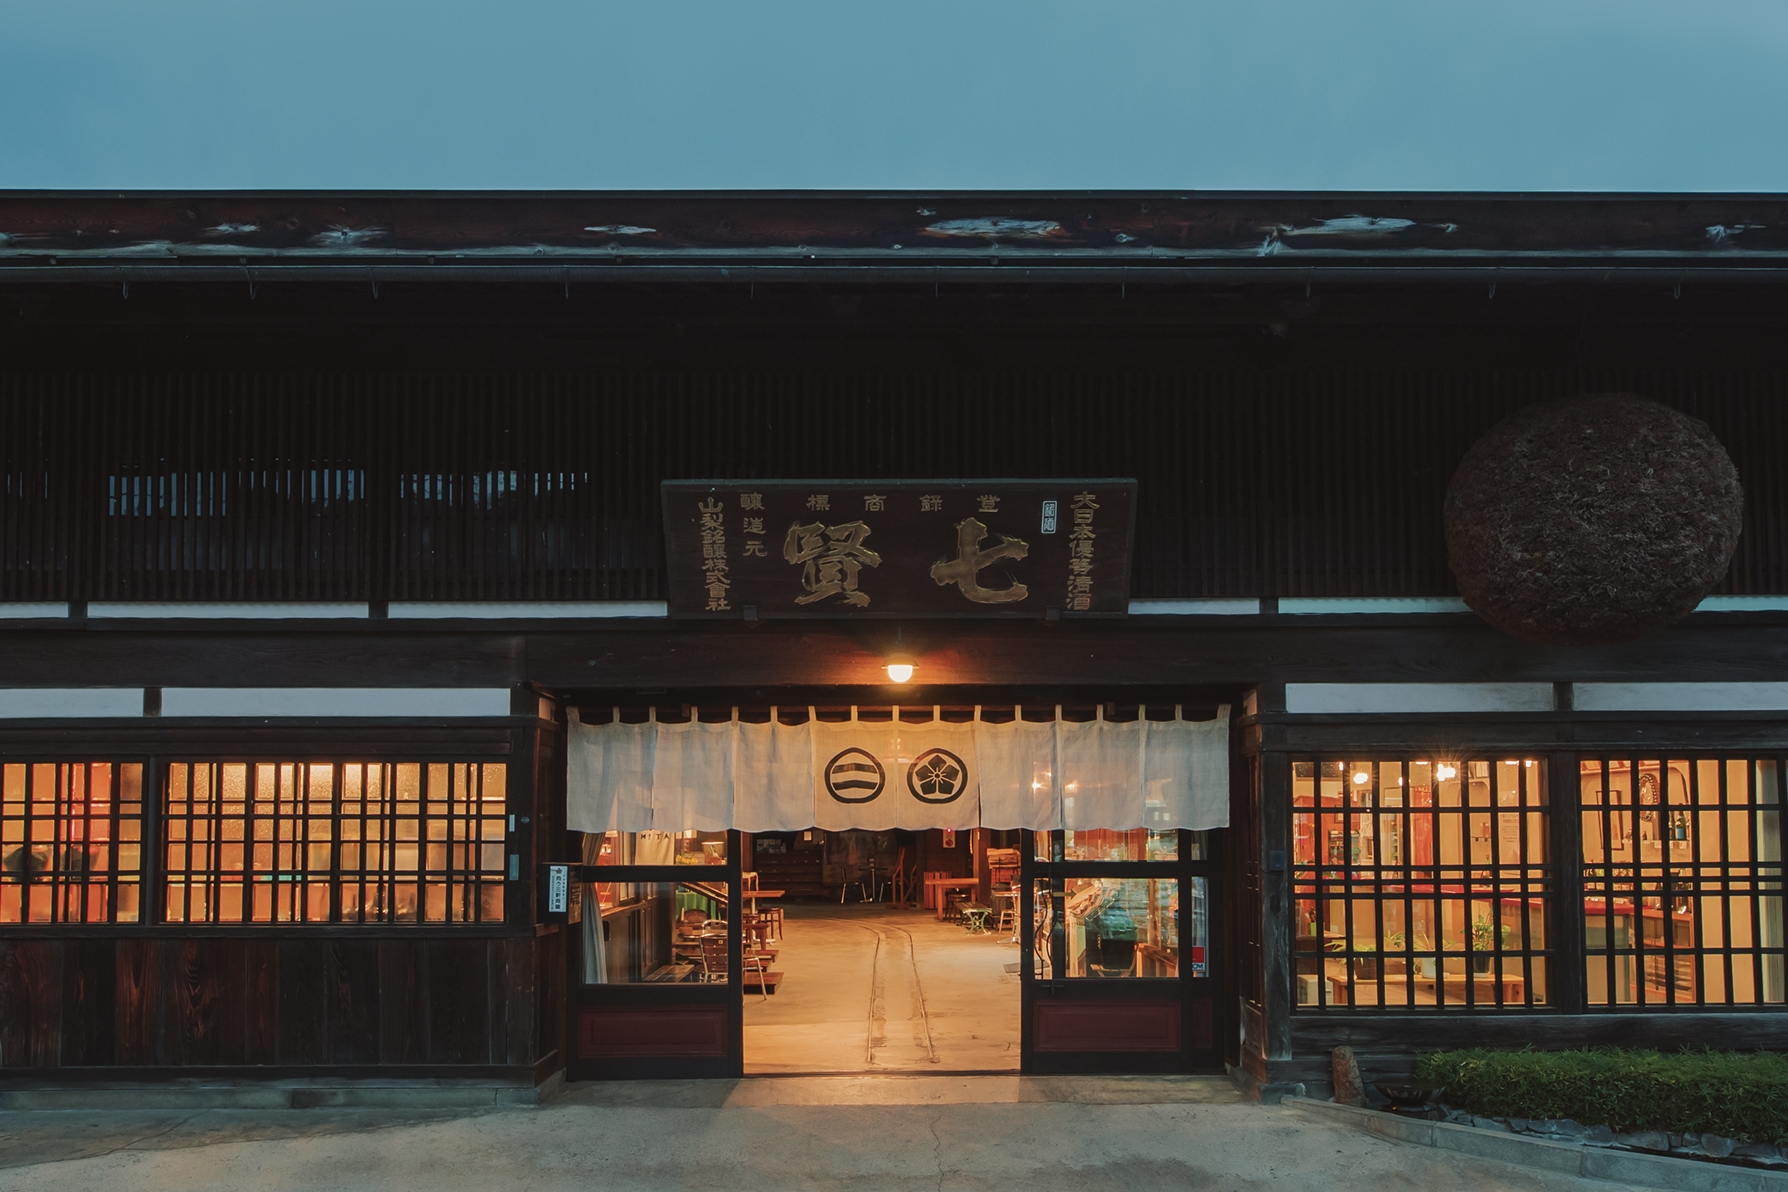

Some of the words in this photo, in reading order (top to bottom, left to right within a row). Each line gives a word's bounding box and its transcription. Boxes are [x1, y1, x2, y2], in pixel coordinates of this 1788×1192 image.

[1066, 491, 1101, 611] 大日本優等清酒
